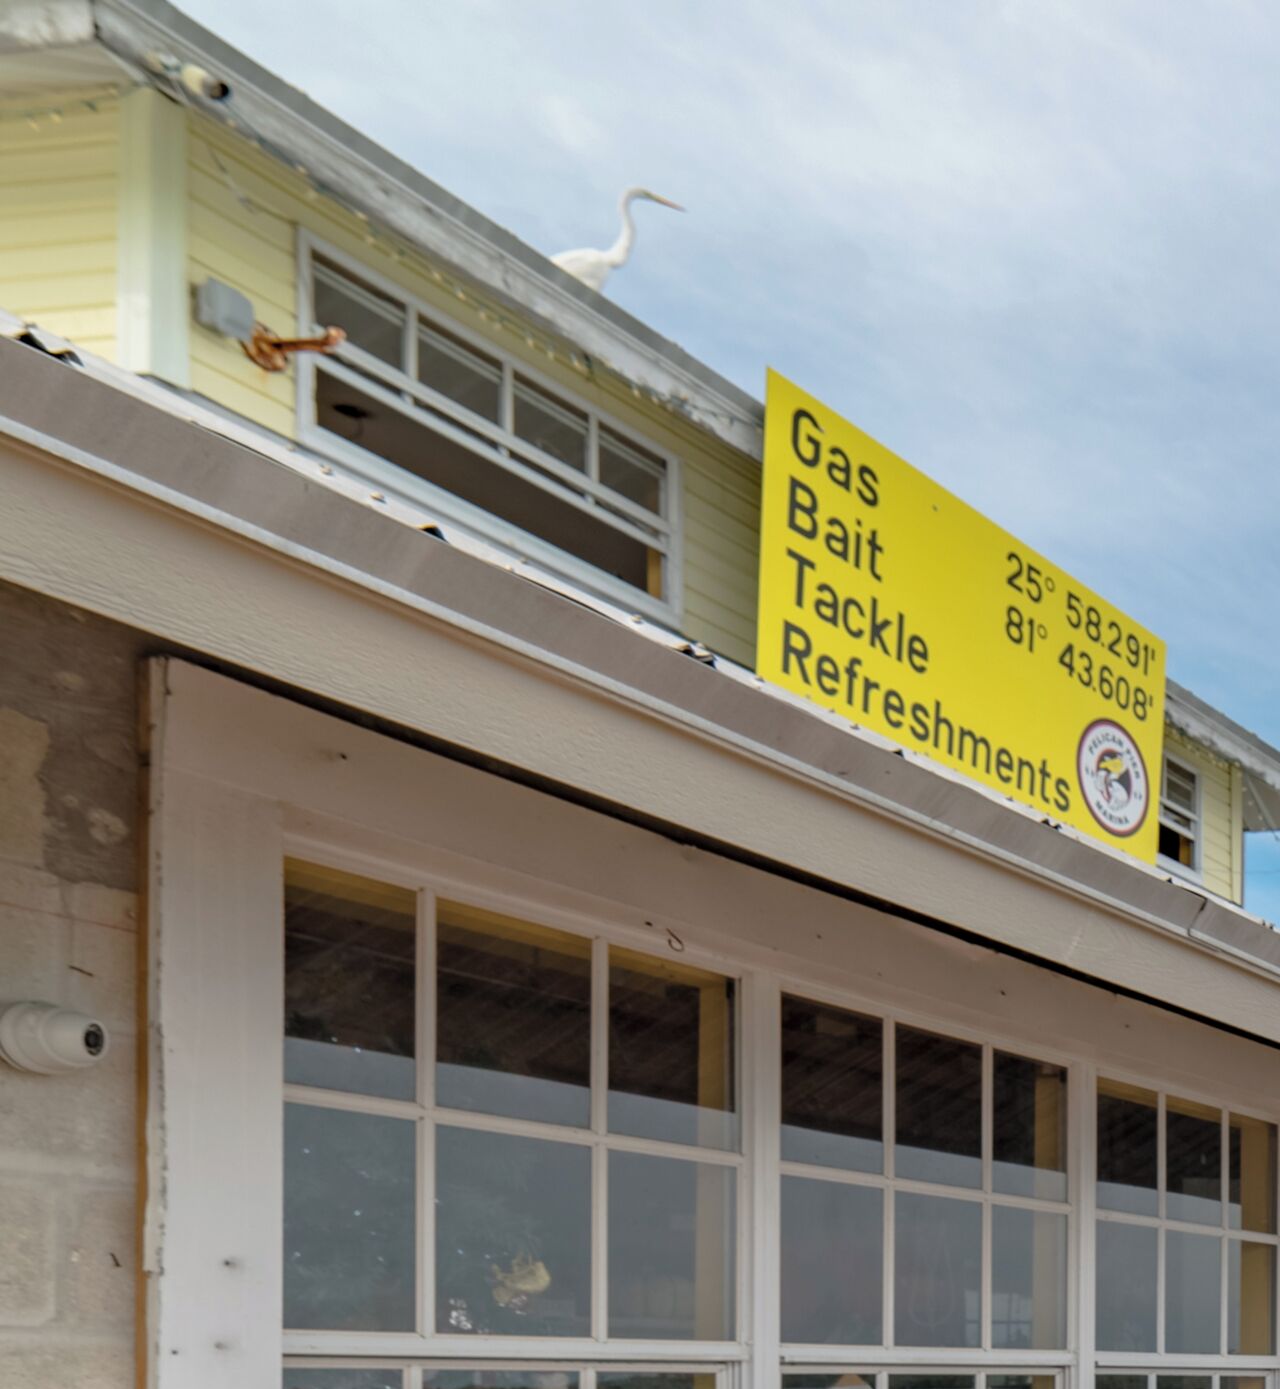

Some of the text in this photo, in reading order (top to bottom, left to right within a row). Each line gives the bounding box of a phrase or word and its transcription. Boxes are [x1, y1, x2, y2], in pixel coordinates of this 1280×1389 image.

[791, 408, 880, 507] Gas
[788, 475, 884, 582] Bait
[785, 547, 929, 674] Tackle
[782, 620, 1071, 813] Refreshments
[1088, 733, 1124, 755] PELICAN
[1095, 800, 1130, 824] MARINA
